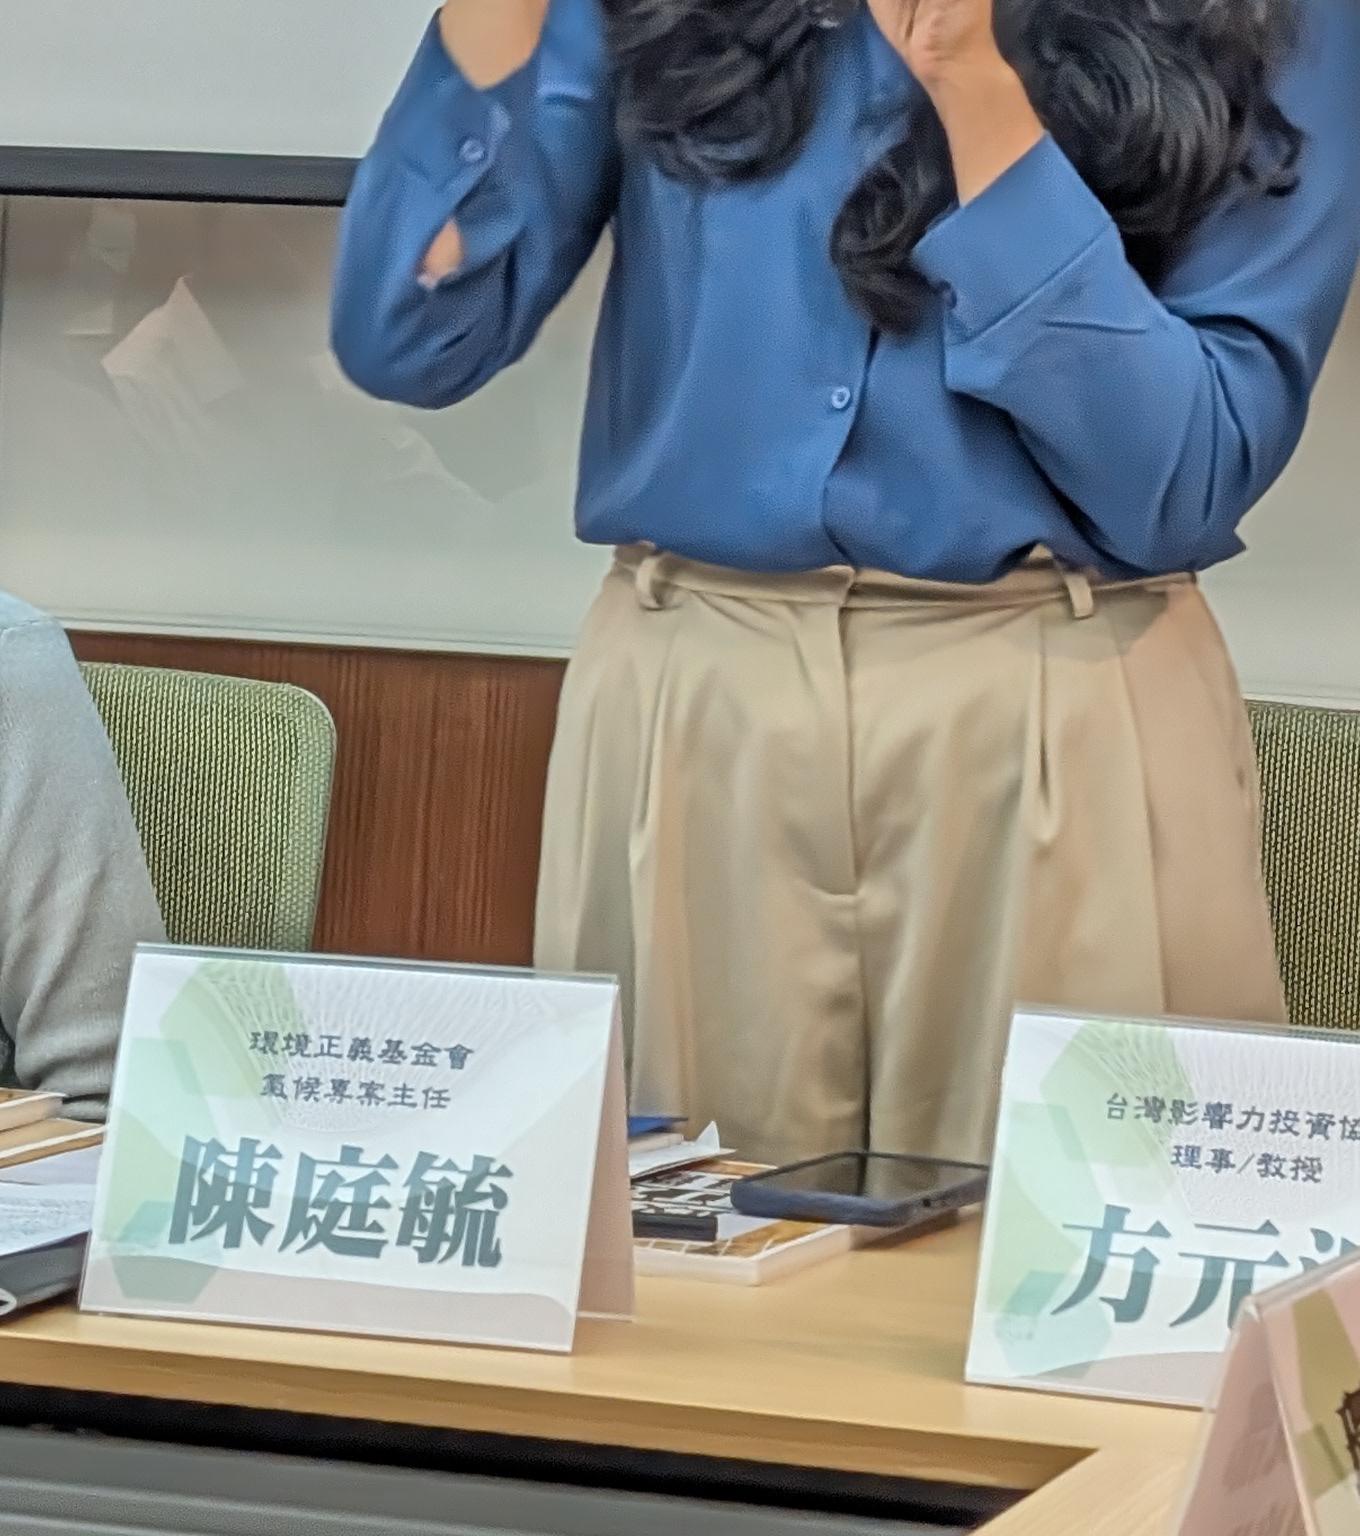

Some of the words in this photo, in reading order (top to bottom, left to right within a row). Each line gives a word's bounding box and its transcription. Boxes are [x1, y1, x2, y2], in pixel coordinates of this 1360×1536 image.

[248, 1029, 474, 1071] 環境正義基金會
[259, 1072, 452, 1110] 氣候專案主任
[1170, 1143, 1324, 1185] 理事/教授
[168, 1134, 514, 1269] 陳庭毓
[1050, 1203, 1360, 1330] 方元
